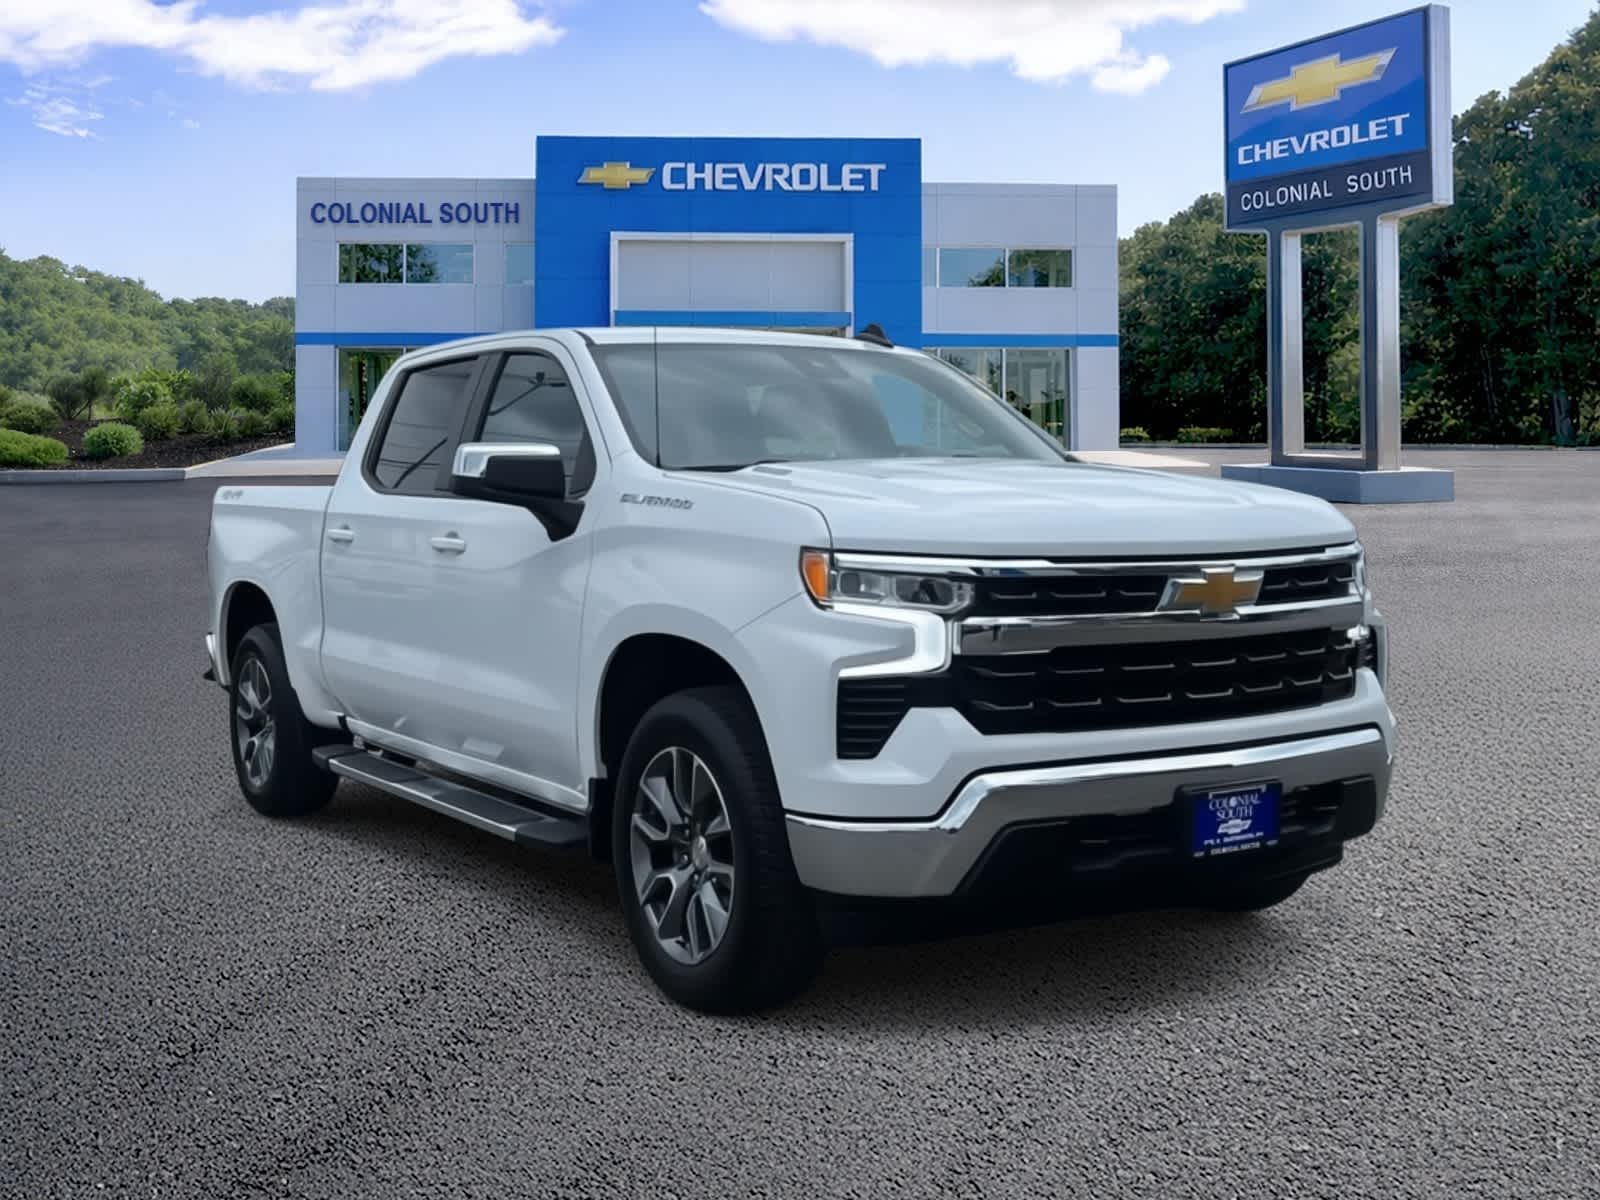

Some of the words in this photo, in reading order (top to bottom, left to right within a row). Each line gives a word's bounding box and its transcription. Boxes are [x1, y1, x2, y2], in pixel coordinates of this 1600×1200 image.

[1237, 113, 1410, 165] CHEVROLET
[662, 162, 886, 192] CHEVROLET
[1241, 180, 1333, 211] COLONIAL
[1346, 165, 1413, 193] SOUTH
[310, 202, 433, 225] COLONIAL
[439, 203, 520, 225] SOUTH
